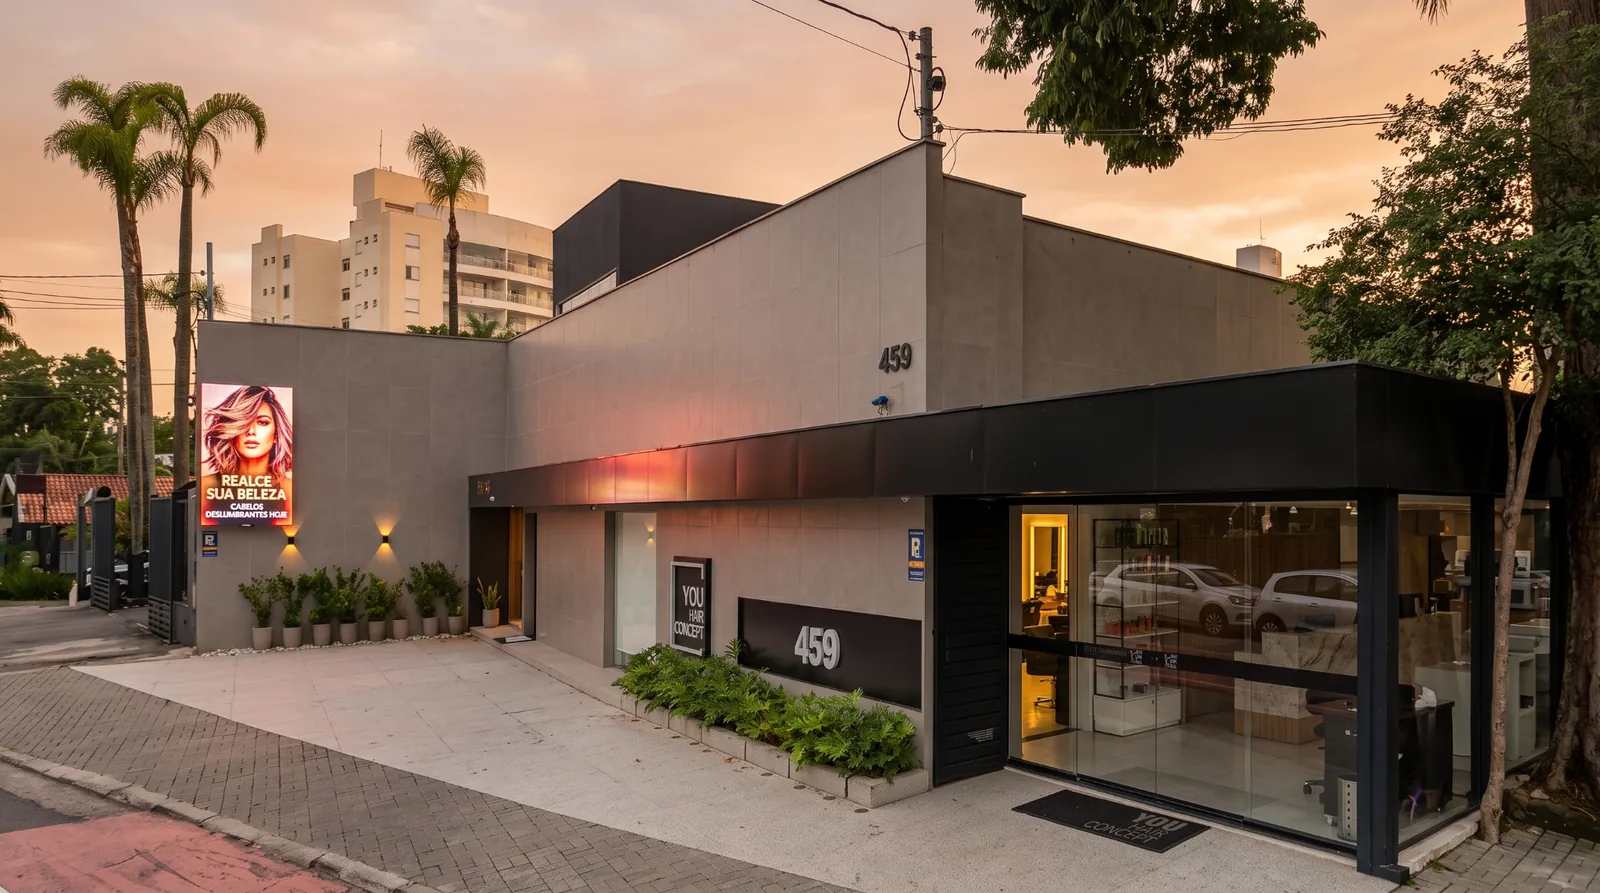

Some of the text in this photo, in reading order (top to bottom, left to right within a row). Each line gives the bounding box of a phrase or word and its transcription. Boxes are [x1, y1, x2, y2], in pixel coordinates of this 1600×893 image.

[878, 342, 912, 373] 459
[221, 474, 272, 487] REALCE
[206, 488, 287, 500] SUA BELEZA
[682, 585, 704, 607] YOU
[688, 608, 704, 624] HAIR
[673, 620, 704, 640] CONCEPT
[794, 625, 841, 670] 459
[1083, 820, 1159, 844] CONCEPT
[1128, 823, 1169, 838] HAIR
[1132, 812, 1188, 832] YOU
